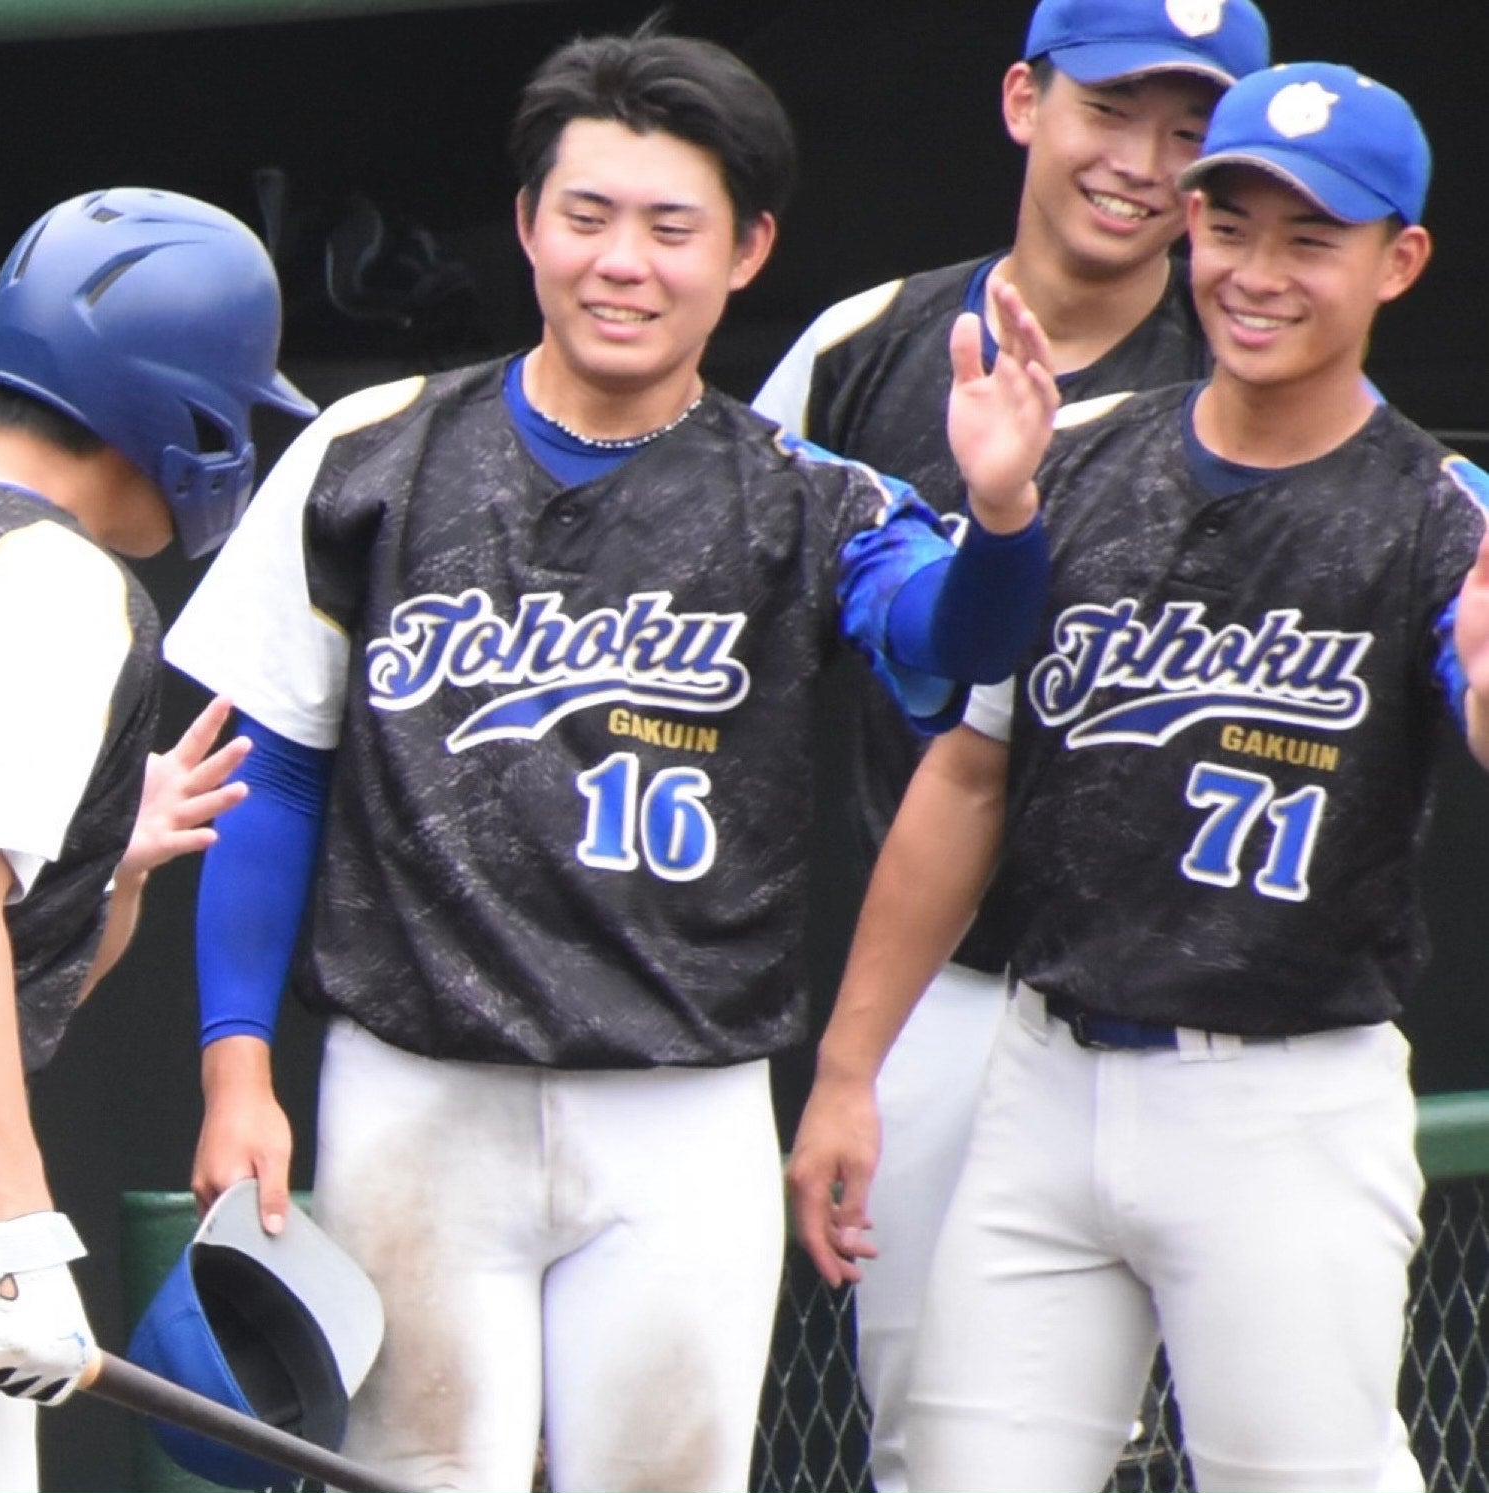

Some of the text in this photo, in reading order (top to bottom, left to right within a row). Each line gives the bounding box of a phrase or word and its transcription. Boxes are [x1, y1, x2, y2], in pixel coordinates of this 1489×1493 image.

[366, 588, 749, 712] Tohoku
[1029, 598, 1374, 728] Tohoku
[608, 708, 719, 754] GAKUIN
[1220, 724, 1341, 772] GAKUIN
[576, 752, 717, 882] 16
[1181, 761, 1327, 902] 71
